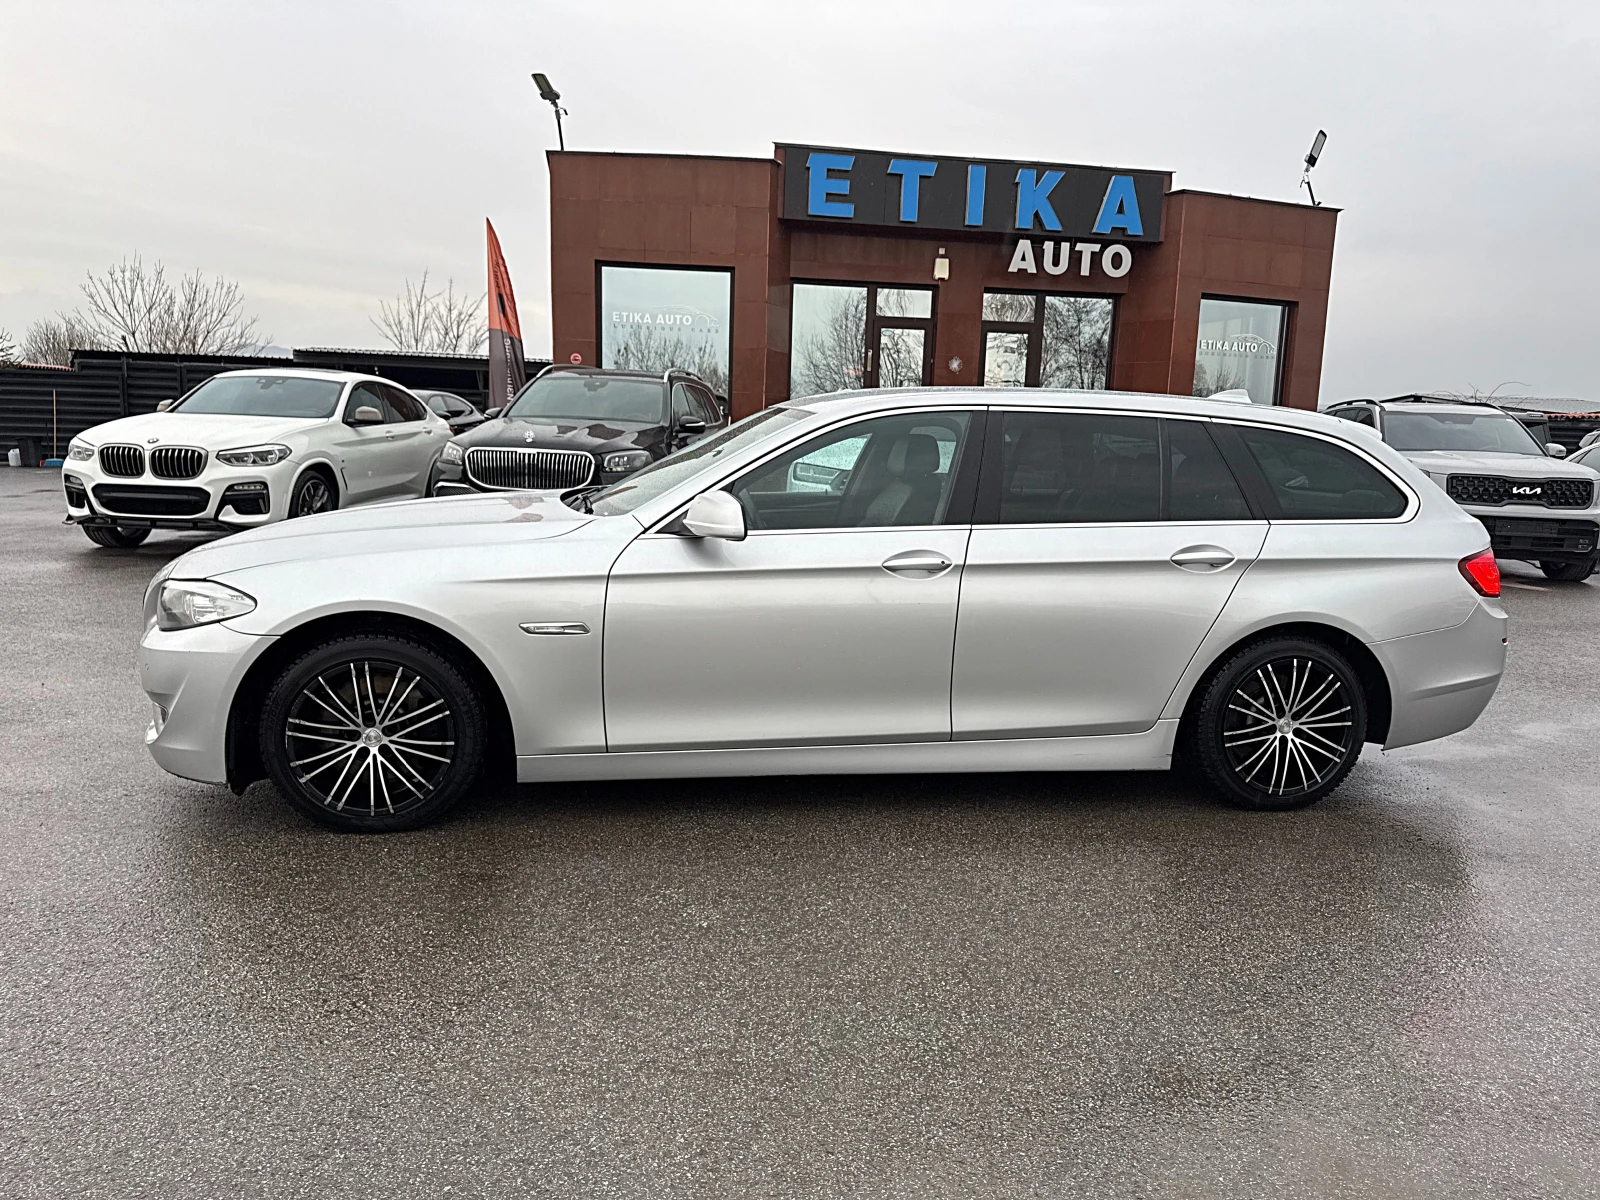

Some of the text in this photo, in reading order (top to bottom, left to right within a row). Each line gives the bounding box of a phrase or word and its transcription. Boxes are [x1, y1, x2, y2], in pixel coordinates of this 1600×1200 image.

[806, 152, 1144, 236] ETIKA
[1008, 239, 1132, 278] AUTO
[612, 312, 692, 325] ETIKA AUTO
[1200, 340, 1258, 352] ETIKA AUTO
